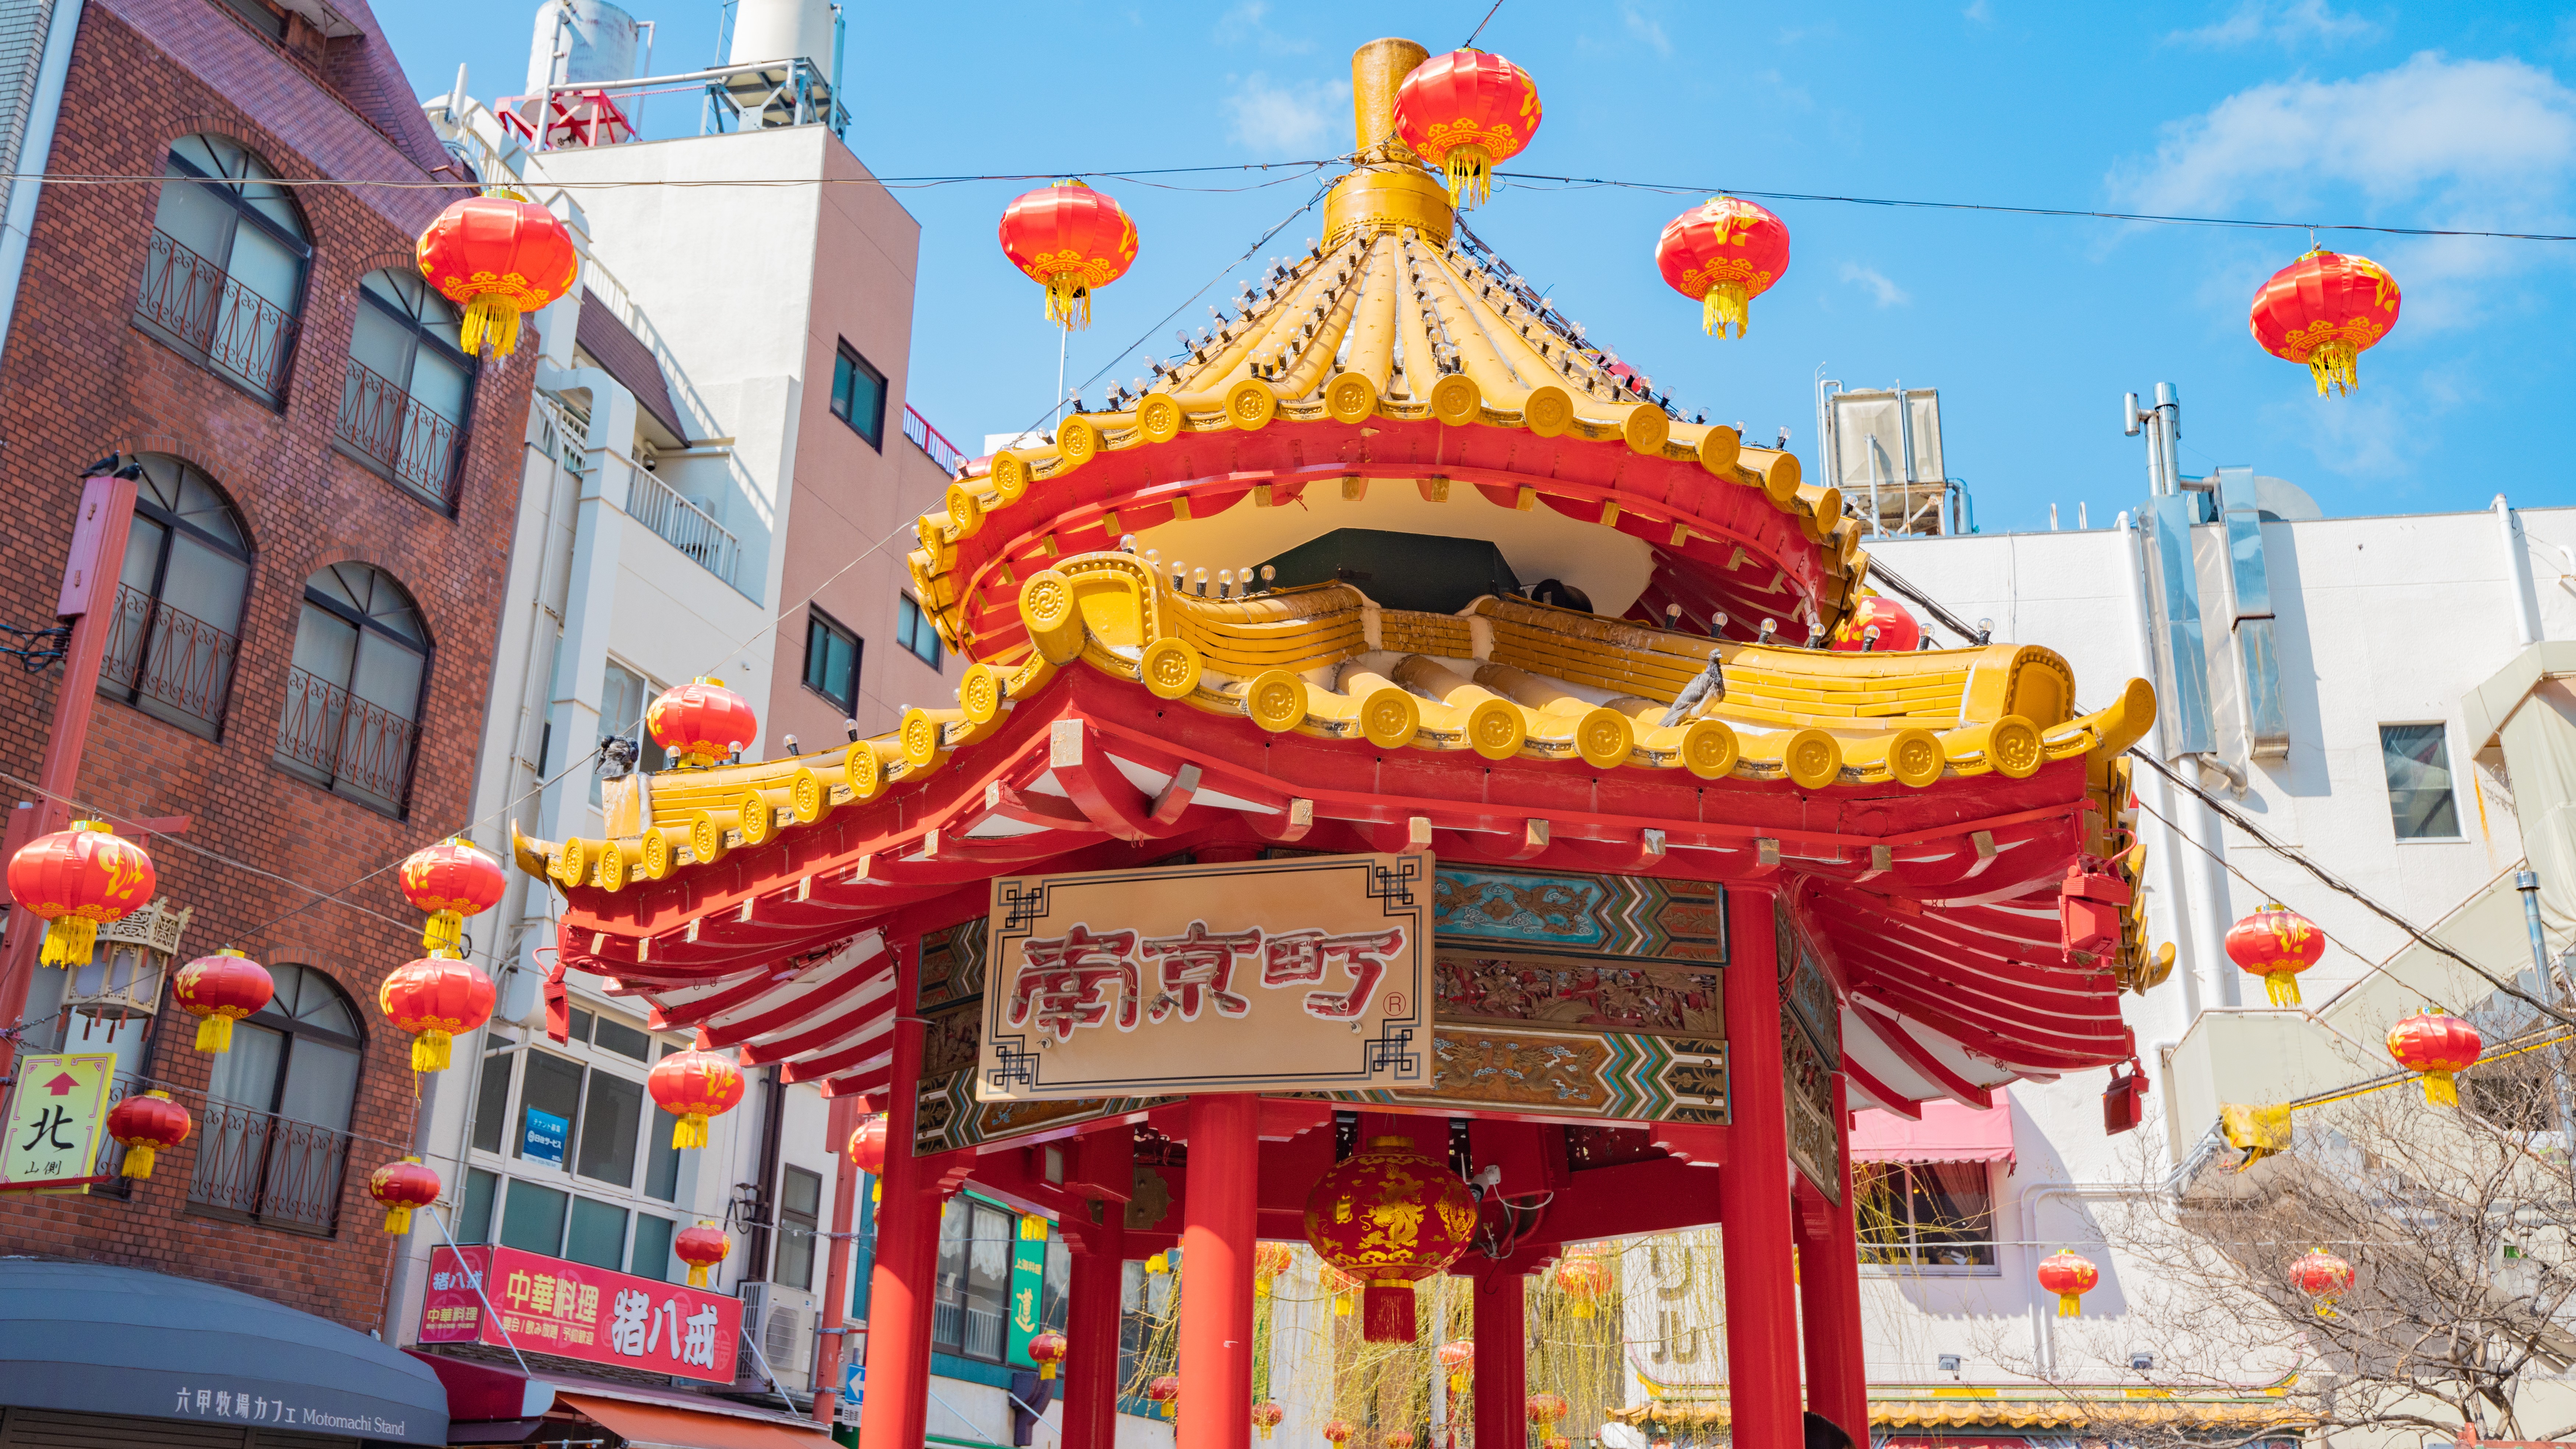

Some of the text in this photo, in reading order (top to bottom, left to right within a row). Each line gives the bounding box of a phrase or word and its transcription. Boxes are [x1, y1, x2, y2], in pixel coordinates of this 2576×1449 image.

[1006, 919, 1407, 1042] 南京町
[22, 1104, 74, 1153] 北
[24, 1160, 62, 1175] 山側
[427, 1307, 478, 1322] 中華料理
[506, 1269, 599, 1324] 中華料理
[611, 1287, 718, 1370] 猪八戒
[175, 1386, 404, 1436] 六甲牧場カフェ Motomachi Stand
